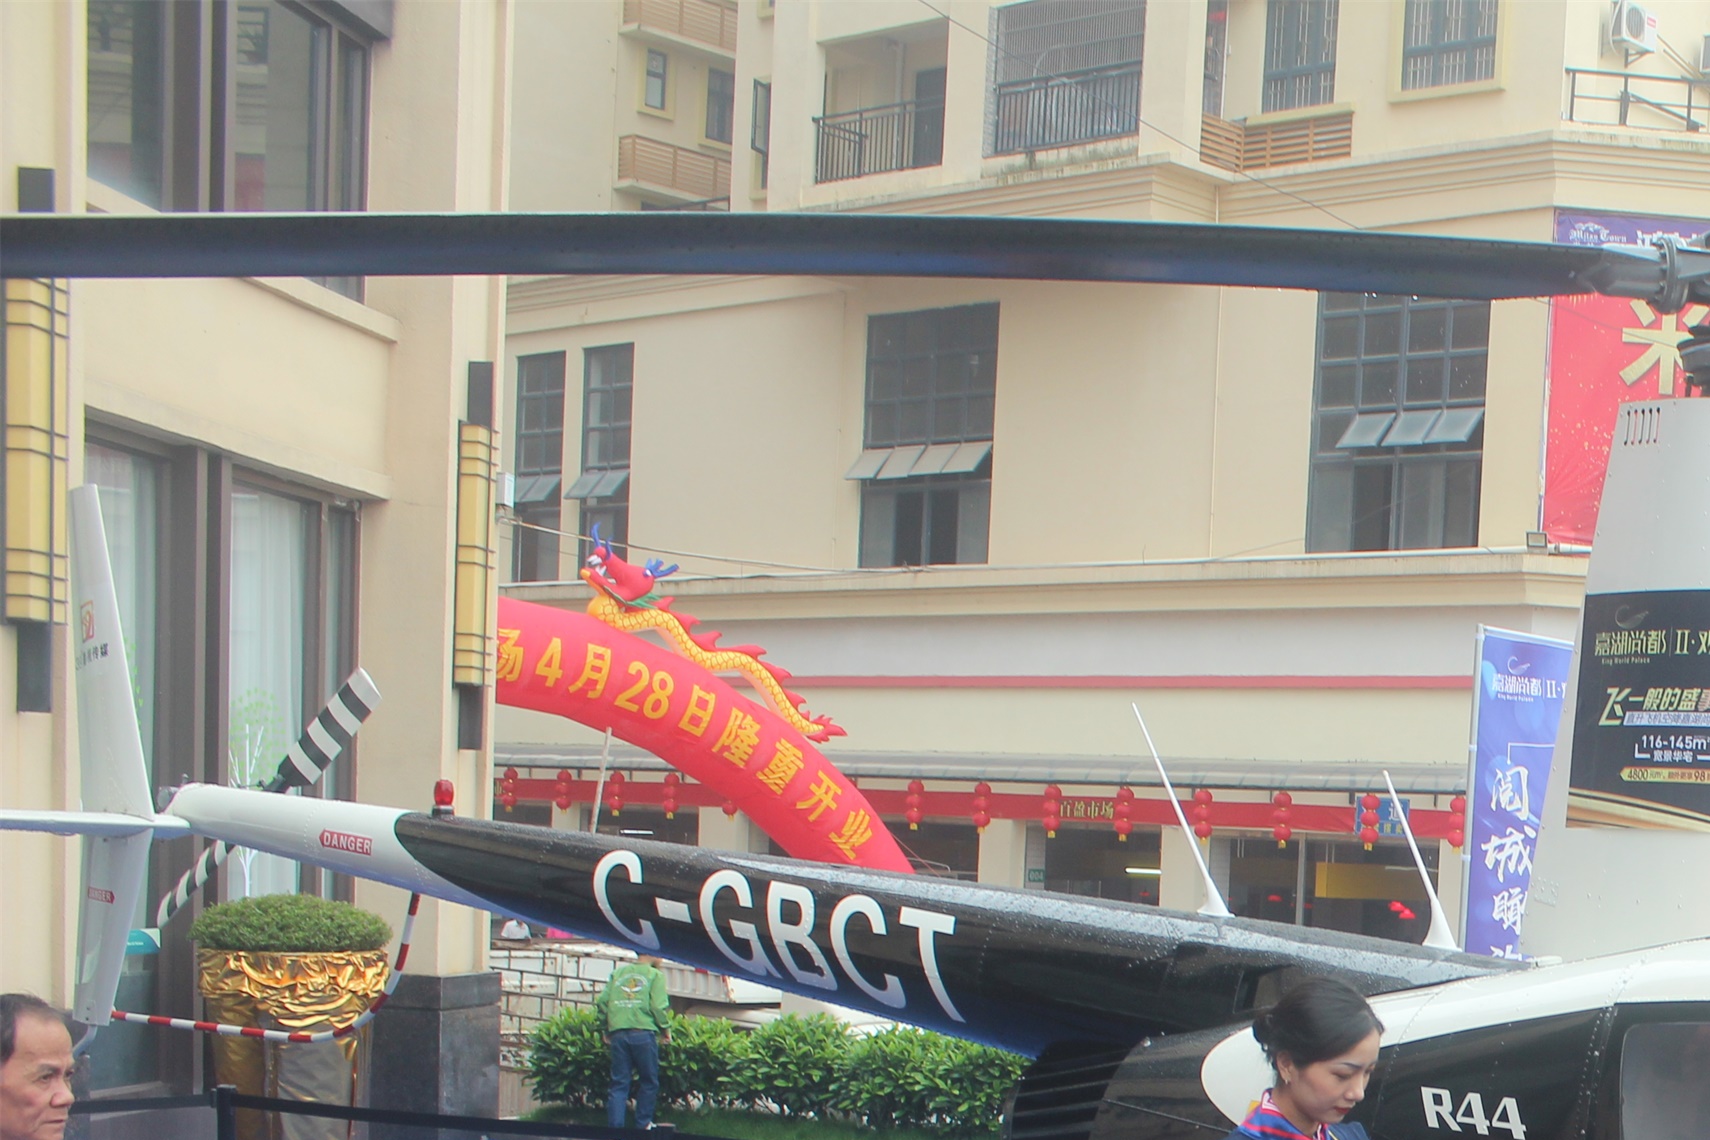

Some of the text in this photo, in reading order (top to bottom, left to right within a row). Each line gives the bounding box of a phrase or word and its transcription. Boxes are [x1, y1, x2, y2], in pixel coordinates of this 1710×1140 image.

[1600, 229, 1627, 243] Town
[323, 831, 371, 854] DANGER
[593, 850, 966, 1023] C-GBCT
[1421, 1086, 1527, 1140] R44
